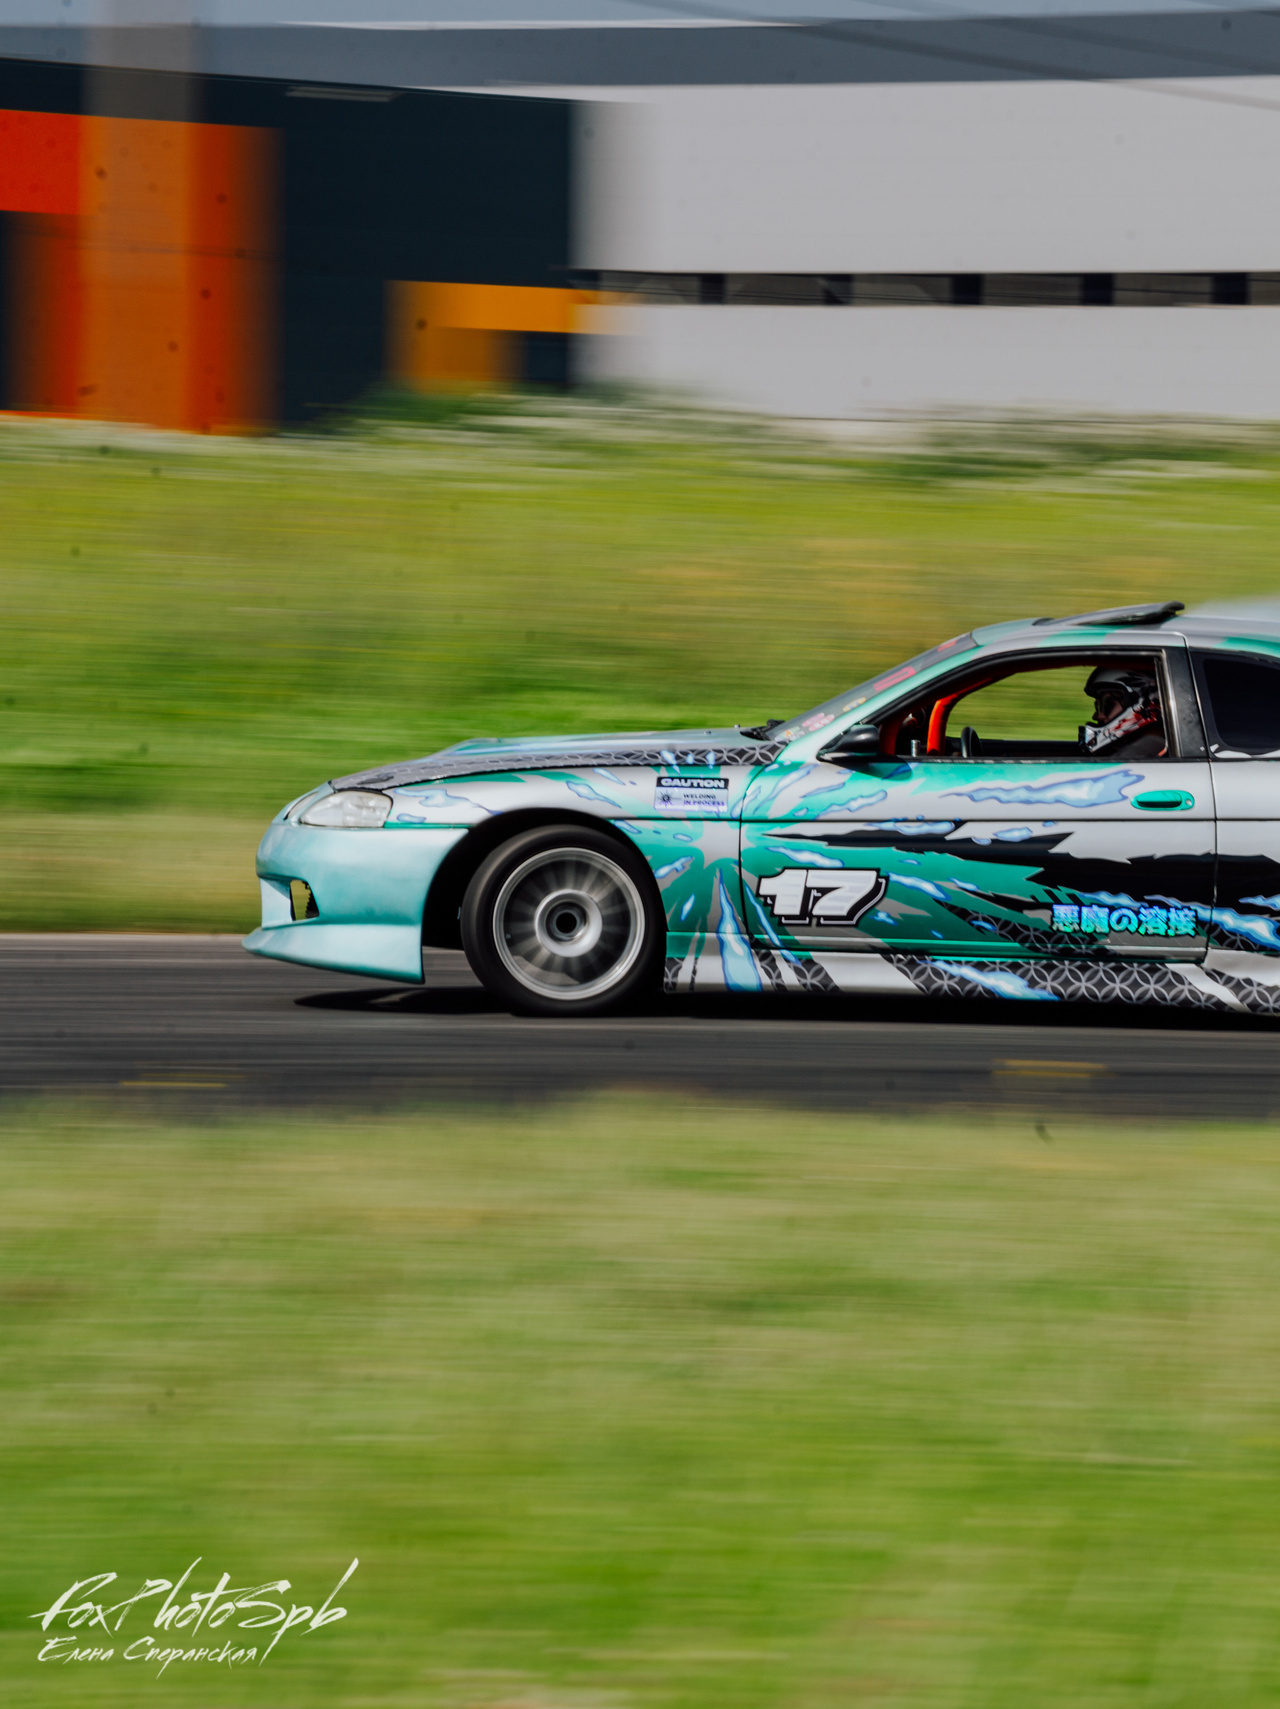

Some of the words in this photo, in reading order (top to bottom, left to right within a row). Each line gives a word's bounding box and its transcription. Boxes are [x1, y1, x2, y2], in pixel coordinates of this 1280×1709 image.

[660, 777, 726, 789] CAUTION
[757, 867, 885, 923] 17
[1051, 903, 1197, 937] 悪魔の溶接
